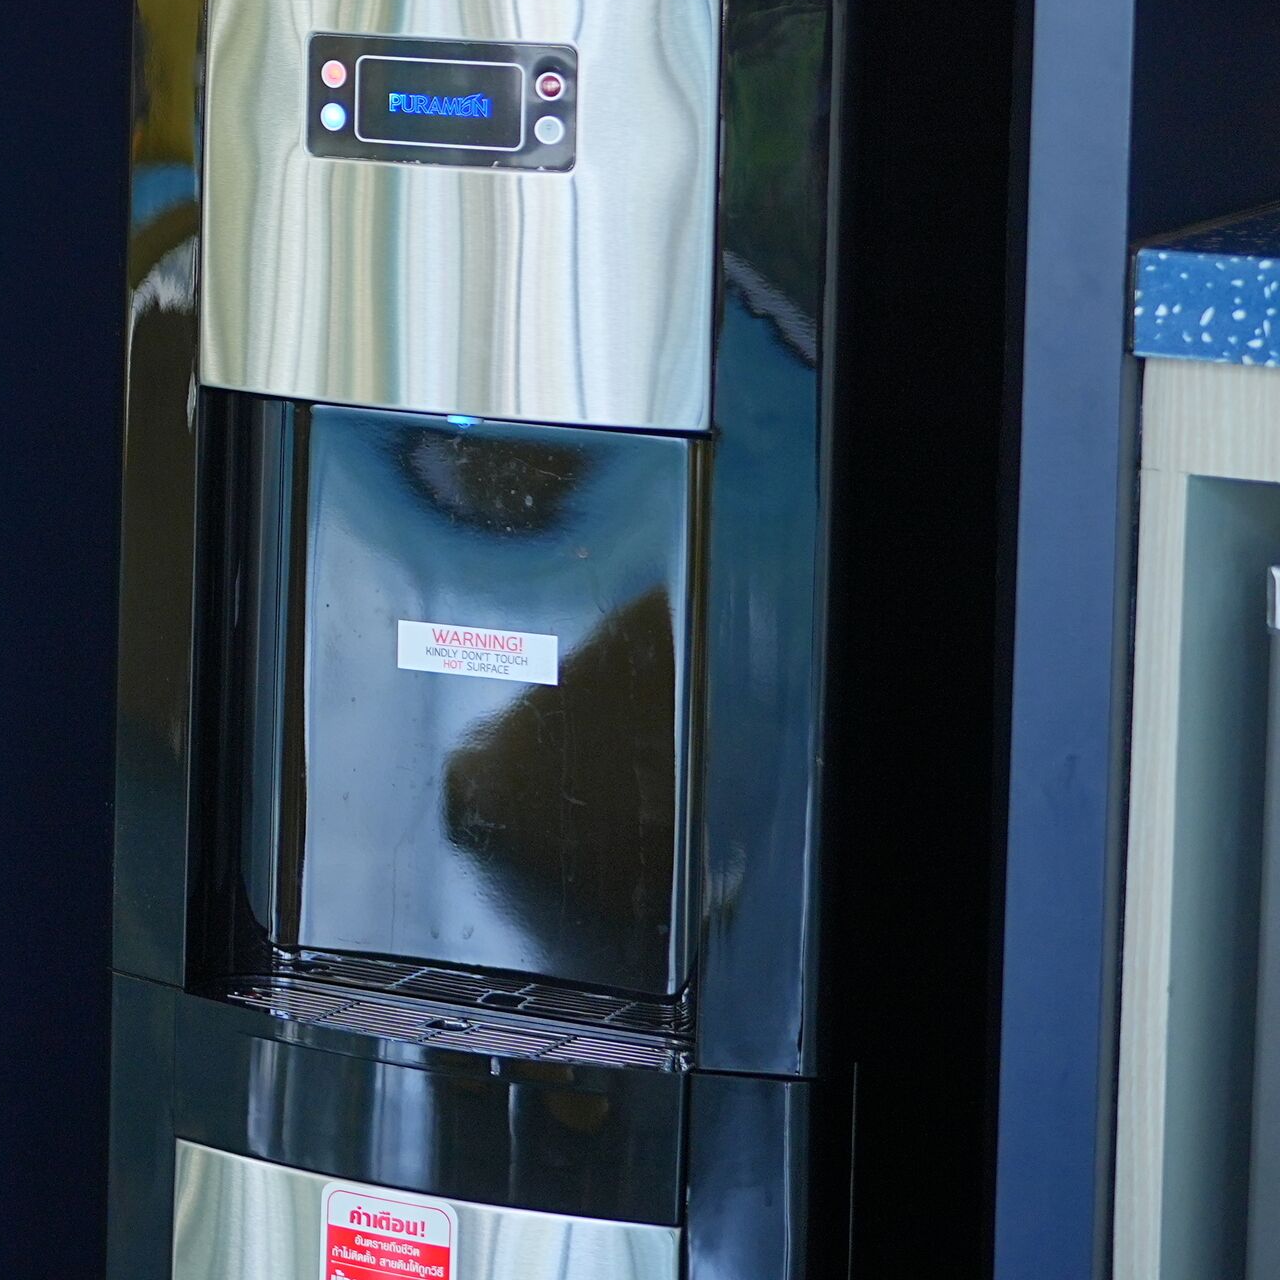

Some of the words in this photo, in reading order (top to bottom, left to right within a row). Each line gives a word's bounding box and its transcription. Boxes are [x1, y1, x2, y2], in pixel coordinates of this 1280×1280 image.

[432, 628, 523, 652] WARNING!
[425, 646, 458, 658] KINDLY
[461, 650, 491, 662] DON'T
[495, 653, 528, 666] TOUCH
[443, 660, 463, 670] HOT
[466, 661, 510, 675] SURFACE
[349, 1205, 425, 1238] คำเตือน!
[354, 1234, 421, 1257] อันตรายถึงชีวิต
[331, 1245, 376, 1264] ถ้าไม่ติดตั้ง
[379, 1259, 445, 1278] สายดินให้ถูกวิธี
